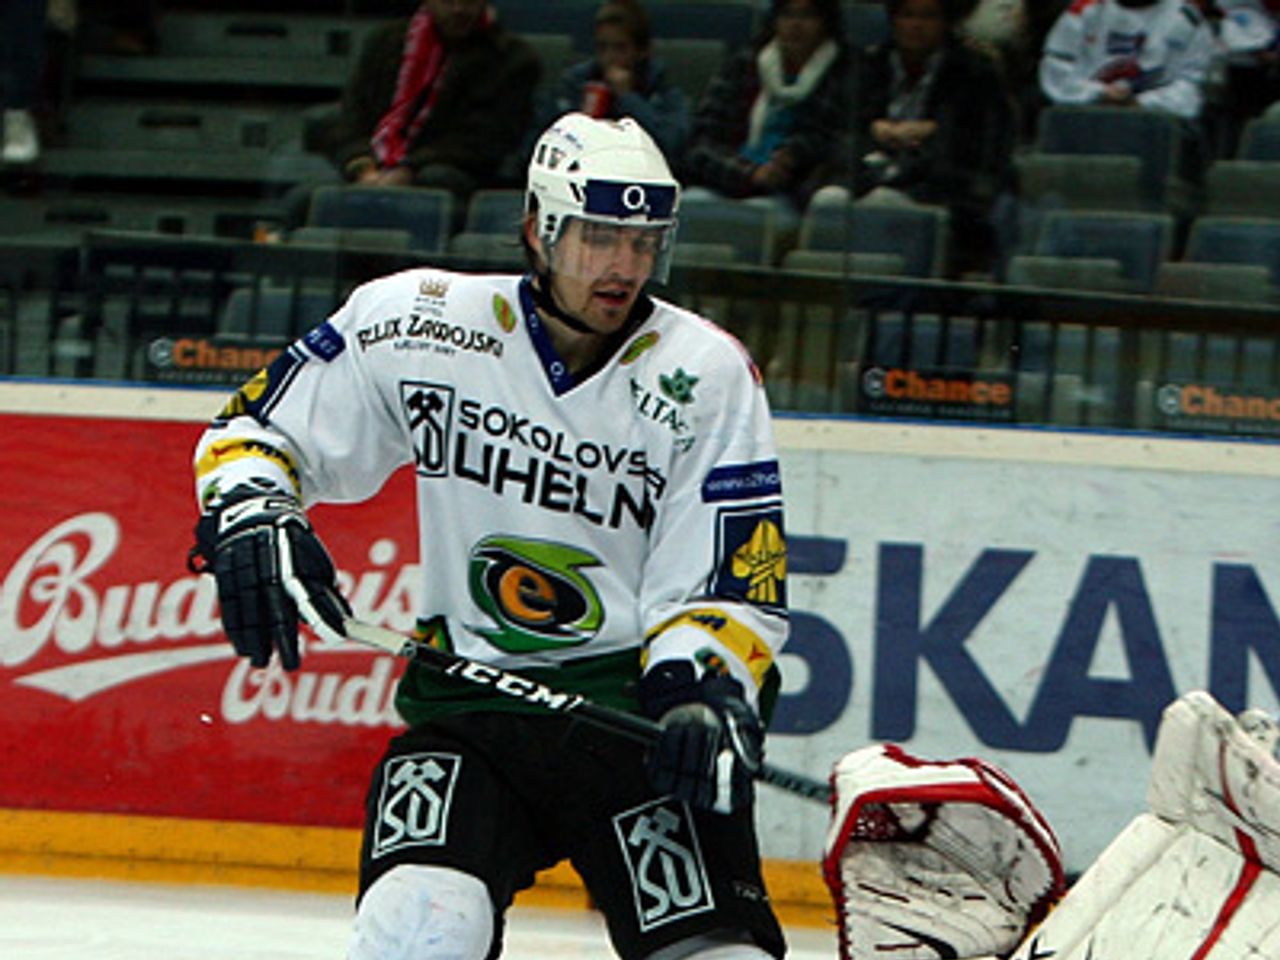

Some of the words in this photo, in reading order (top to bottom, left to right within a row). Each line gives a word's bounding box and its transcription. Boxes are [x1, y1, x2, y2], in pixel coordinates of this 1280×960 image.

[884, 368, 1012, 405] Chance
[454, 431, 657, 530] UHELN
[461, 660, 568, 710] CCM
